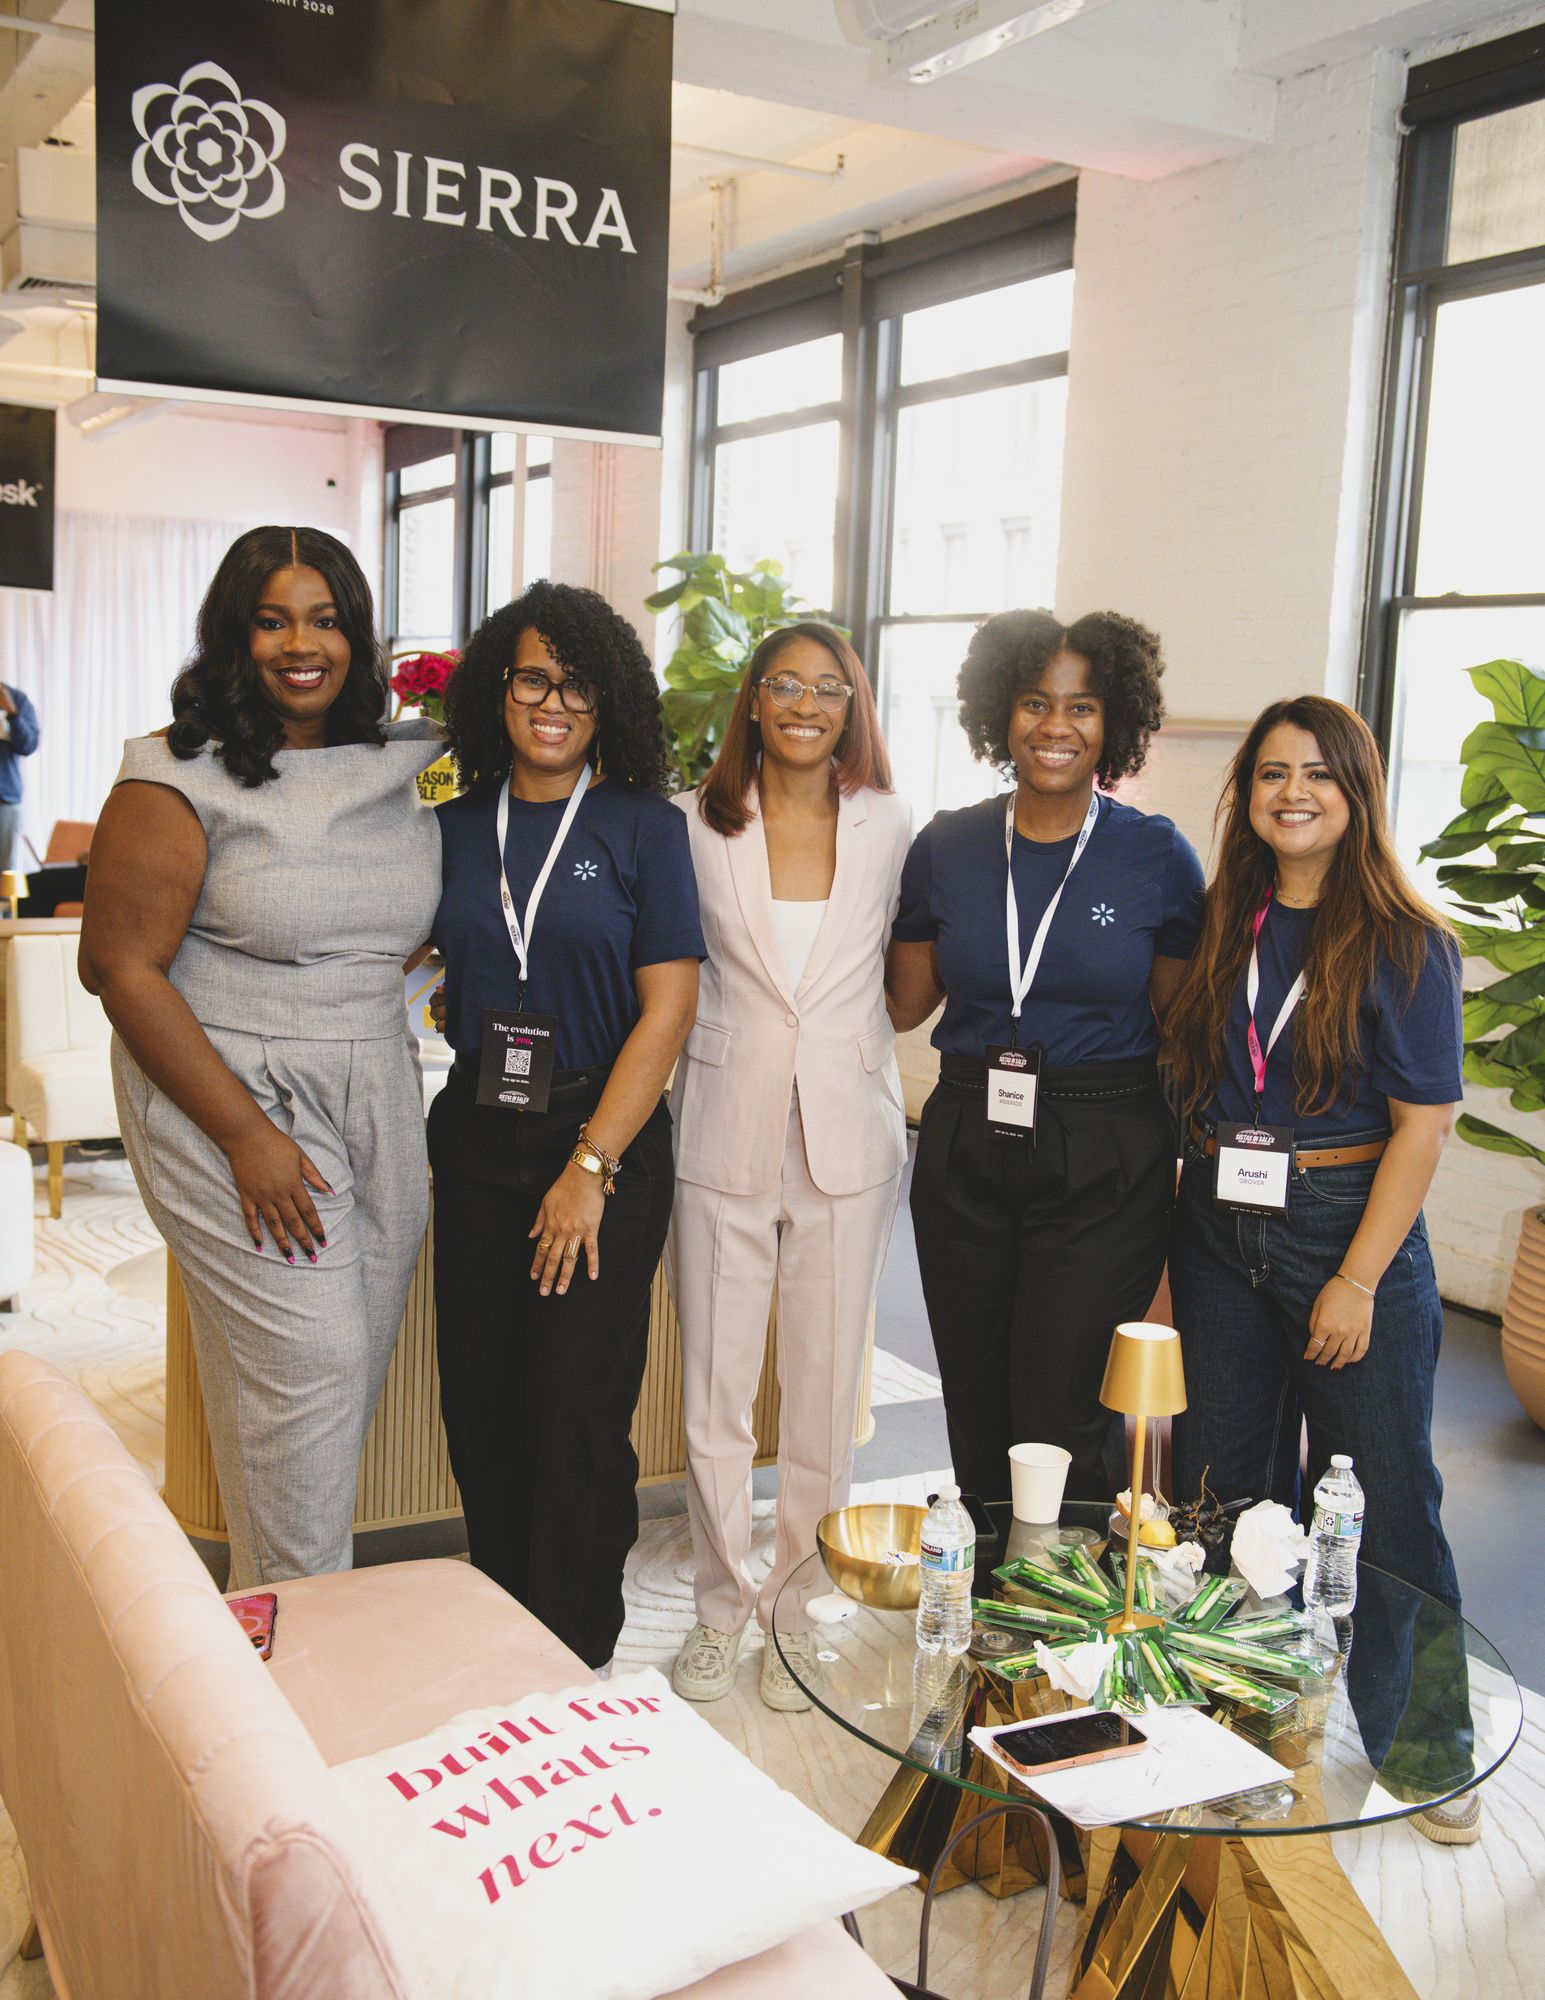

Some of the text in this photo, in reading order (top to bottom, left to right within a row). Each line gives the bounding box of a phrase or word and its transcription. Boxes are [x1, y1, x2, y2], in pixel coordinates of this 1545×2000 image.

[302, 0, 335, 15] 2026
[337, 142, 639, 254] SIERRA
[0, 478, 38, 507] sk
[492, 1022, 550, 1037] The evolution
[506, 1034, 514, 1042] is
[998, 1088, 1024, 1101] Shanice
[1237, 1168, 1268, 1179] Arushi
[1239, 1178, 1265, 1186] GROVER
[385, 1696, 661, 1802] built for
[429, 1737, 650, 1840] whats
[476, 1791, 662, 1905] next.
